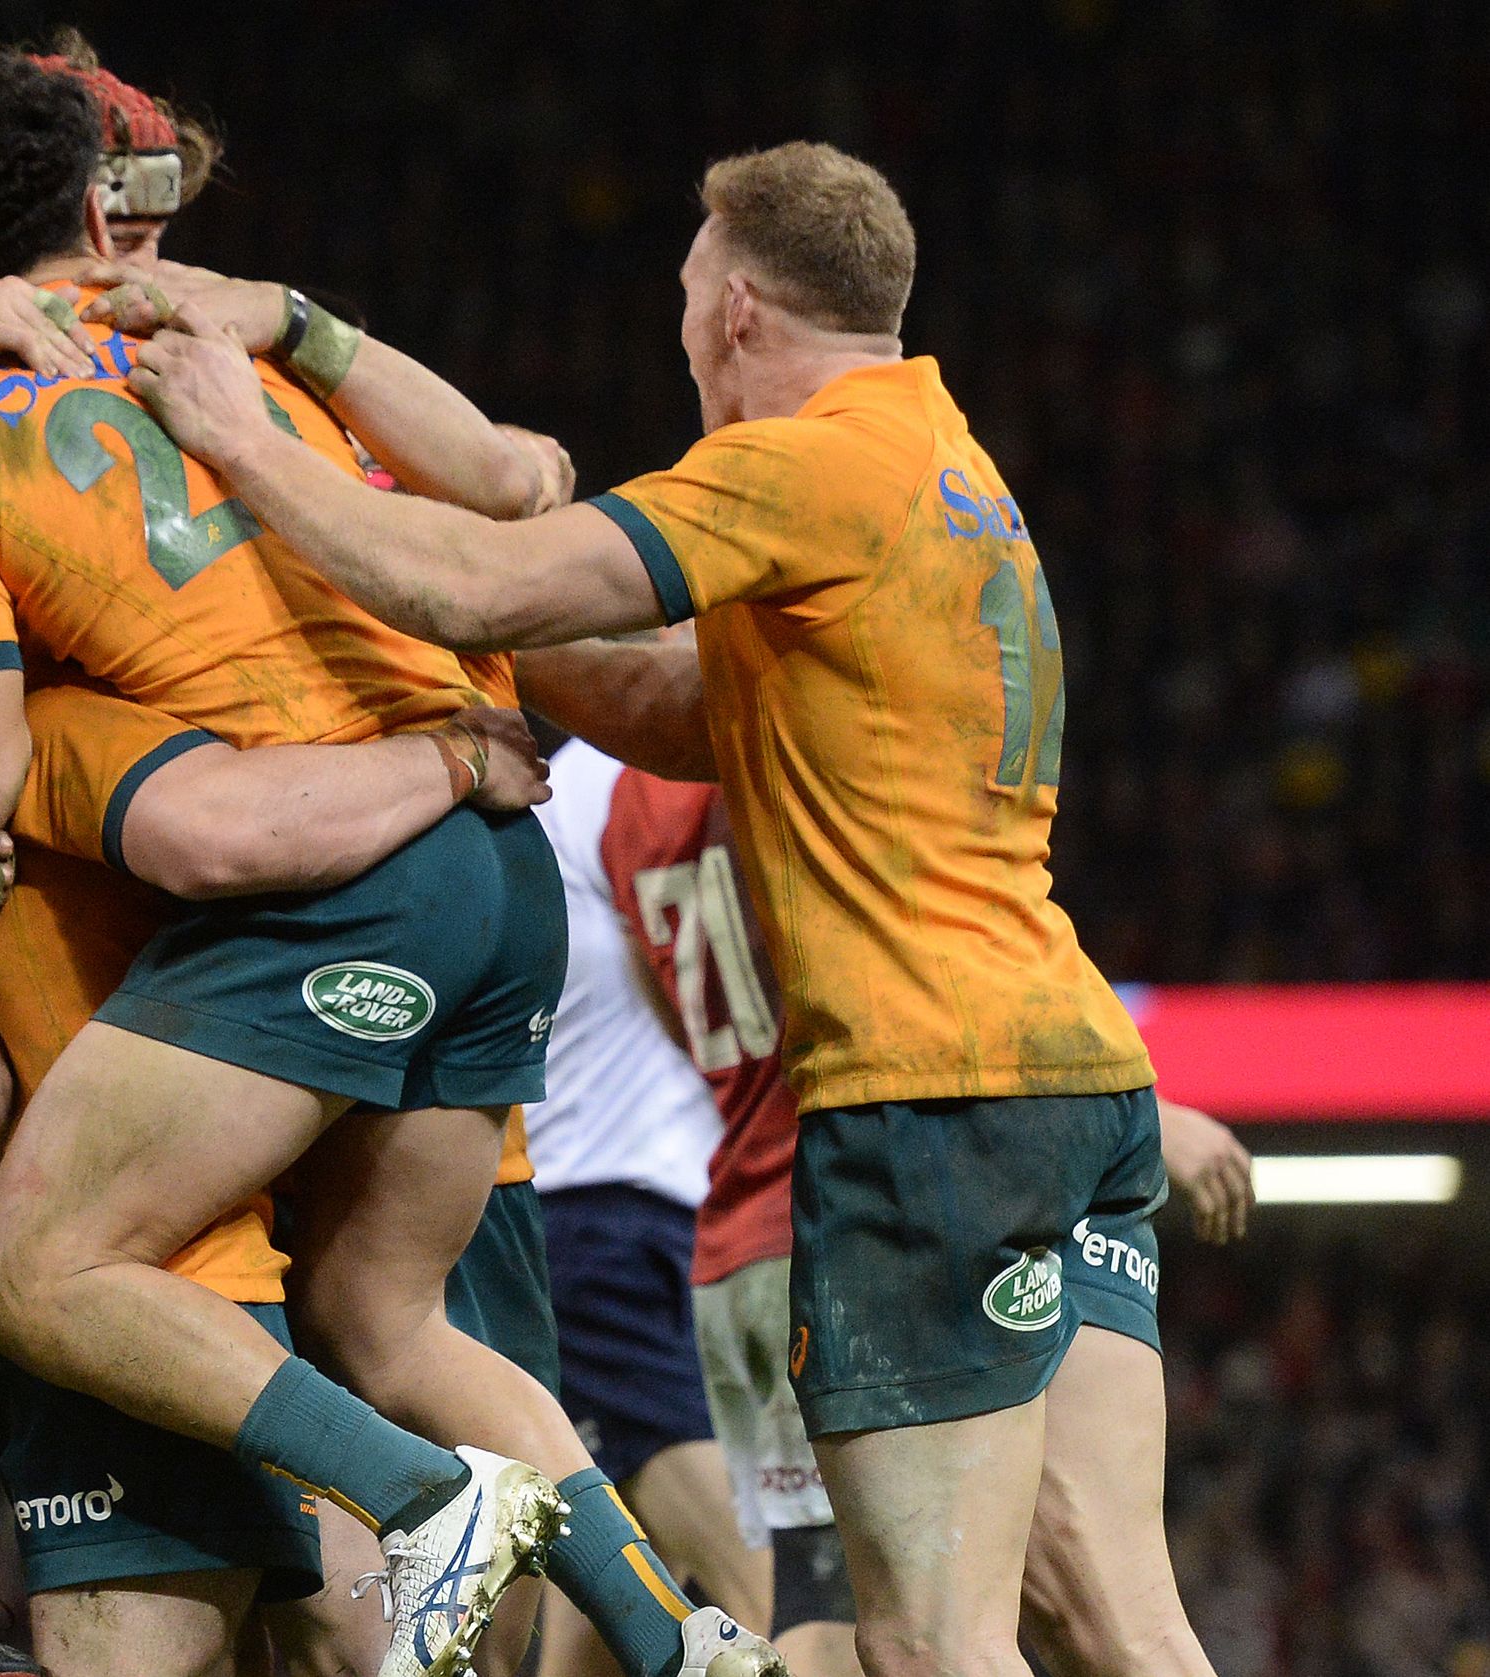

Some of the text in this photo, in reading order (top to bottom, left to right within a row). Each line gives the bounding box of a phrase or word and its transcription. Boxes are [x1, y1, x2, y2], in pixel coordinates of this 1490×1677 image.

[44, 386, 304, 591] 2
[633, 844, 780, 1073] 20
[334, 972, 407, 1005] LAND
[333, 994, 414, 1029] ROVER
[1012, 1261, 1051, 1298] LAN
